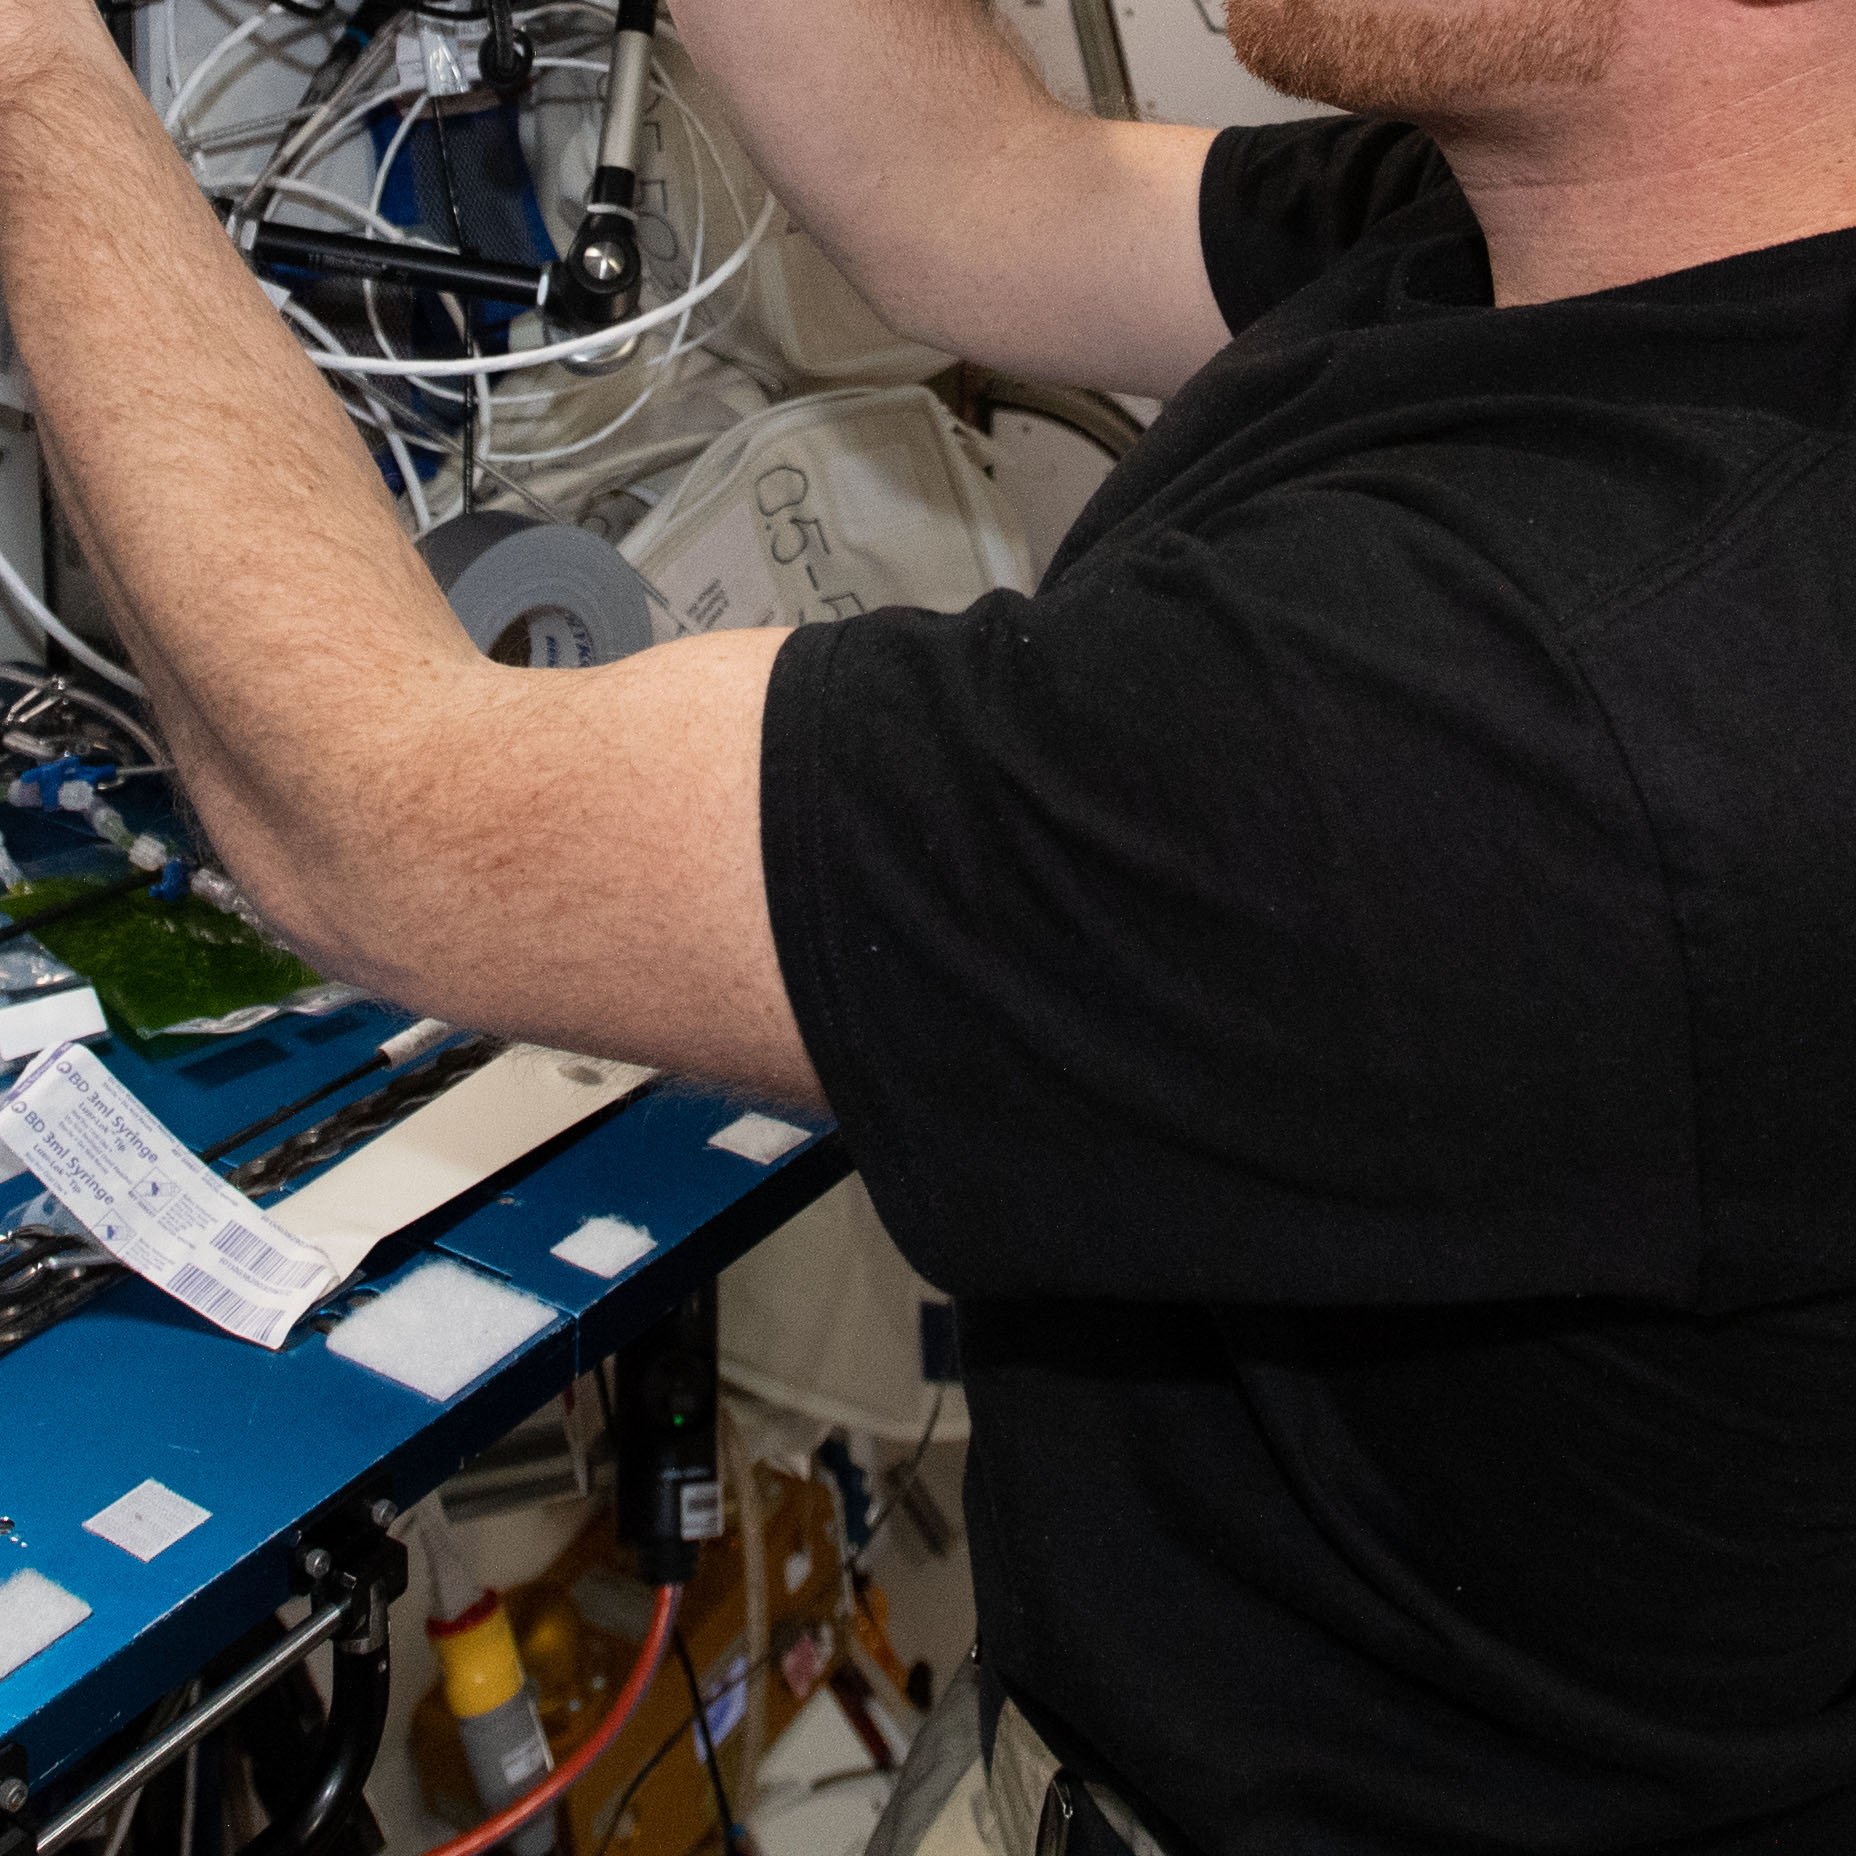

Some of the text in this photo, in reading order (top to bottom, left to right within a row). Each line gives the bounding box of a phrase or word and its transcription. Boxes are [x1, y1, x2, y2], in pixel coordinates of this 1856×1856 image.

[68, 1071, 89, 1093] BD
[86, 1091, 115, 1119] 3ml
[111, 1115, 159, 1164] Syringe
[113, 1137, 127, 1152] Tip
[23, 1111, 46, 1133] BD
[42, 1131, 70, 1159] 3ml
[66, 1155, 115, 1206] Syringe
[68, 1179, 82, 1194] Tip
